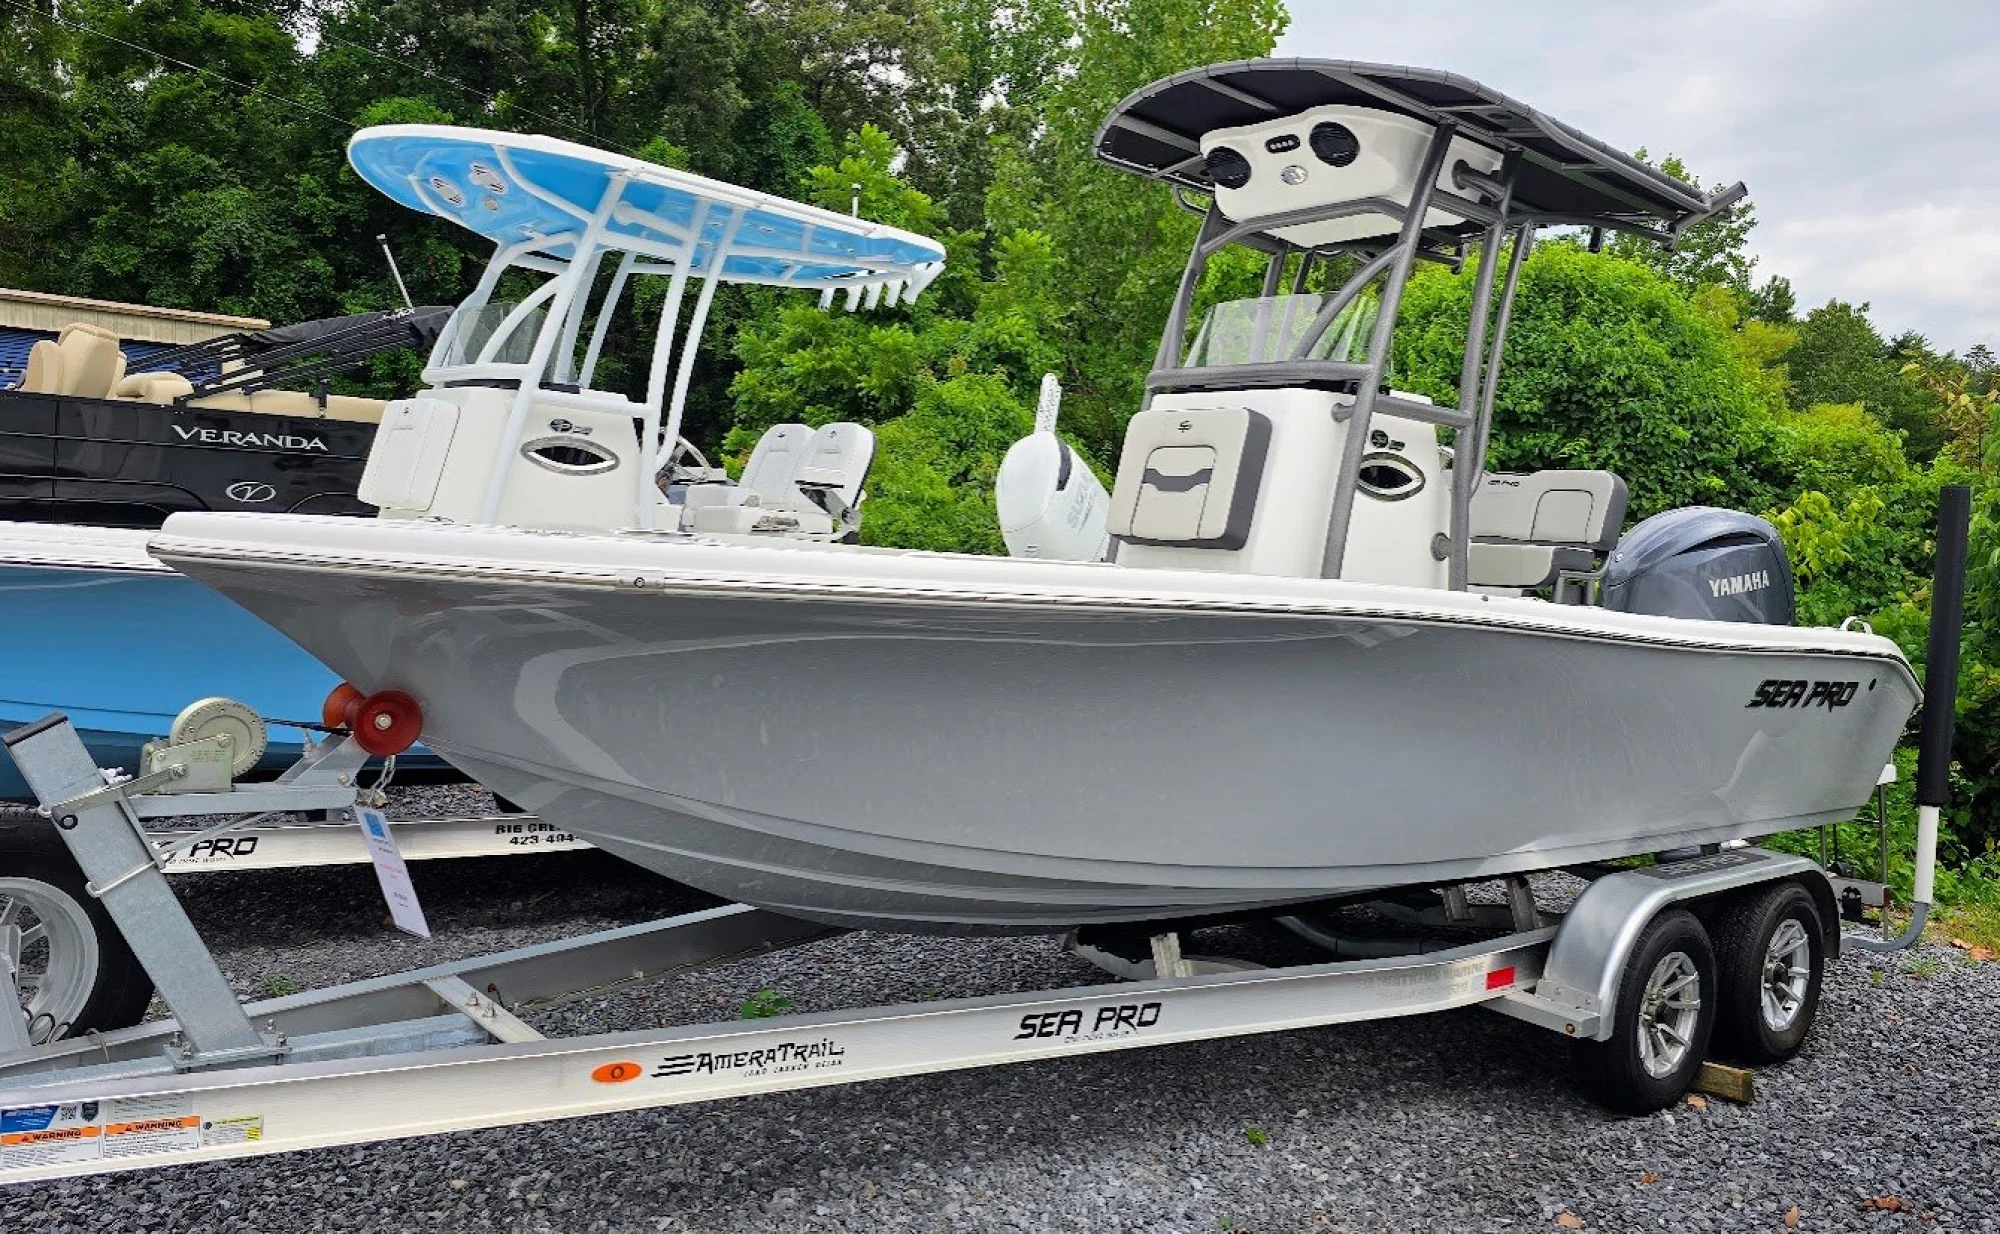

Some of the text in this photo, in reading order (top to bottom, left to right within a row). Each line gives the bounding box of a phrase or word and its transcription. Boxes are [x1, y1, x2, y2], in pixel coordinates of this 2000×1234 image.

[171, 424, 329, 451] VERANDA
[1708, 569, 1770, 598] YAMAHA
[1744, 680, 1860, 712] SEA PRO
[189, 836, 259, 860] PRO
[1012, 1009, 1083, 1041] SEA
[1093, 1002, 1162, 1034] PRO
[32, 1129, 82, 1141] WARNING
[135, 1120, 183, 1132] WARNING
